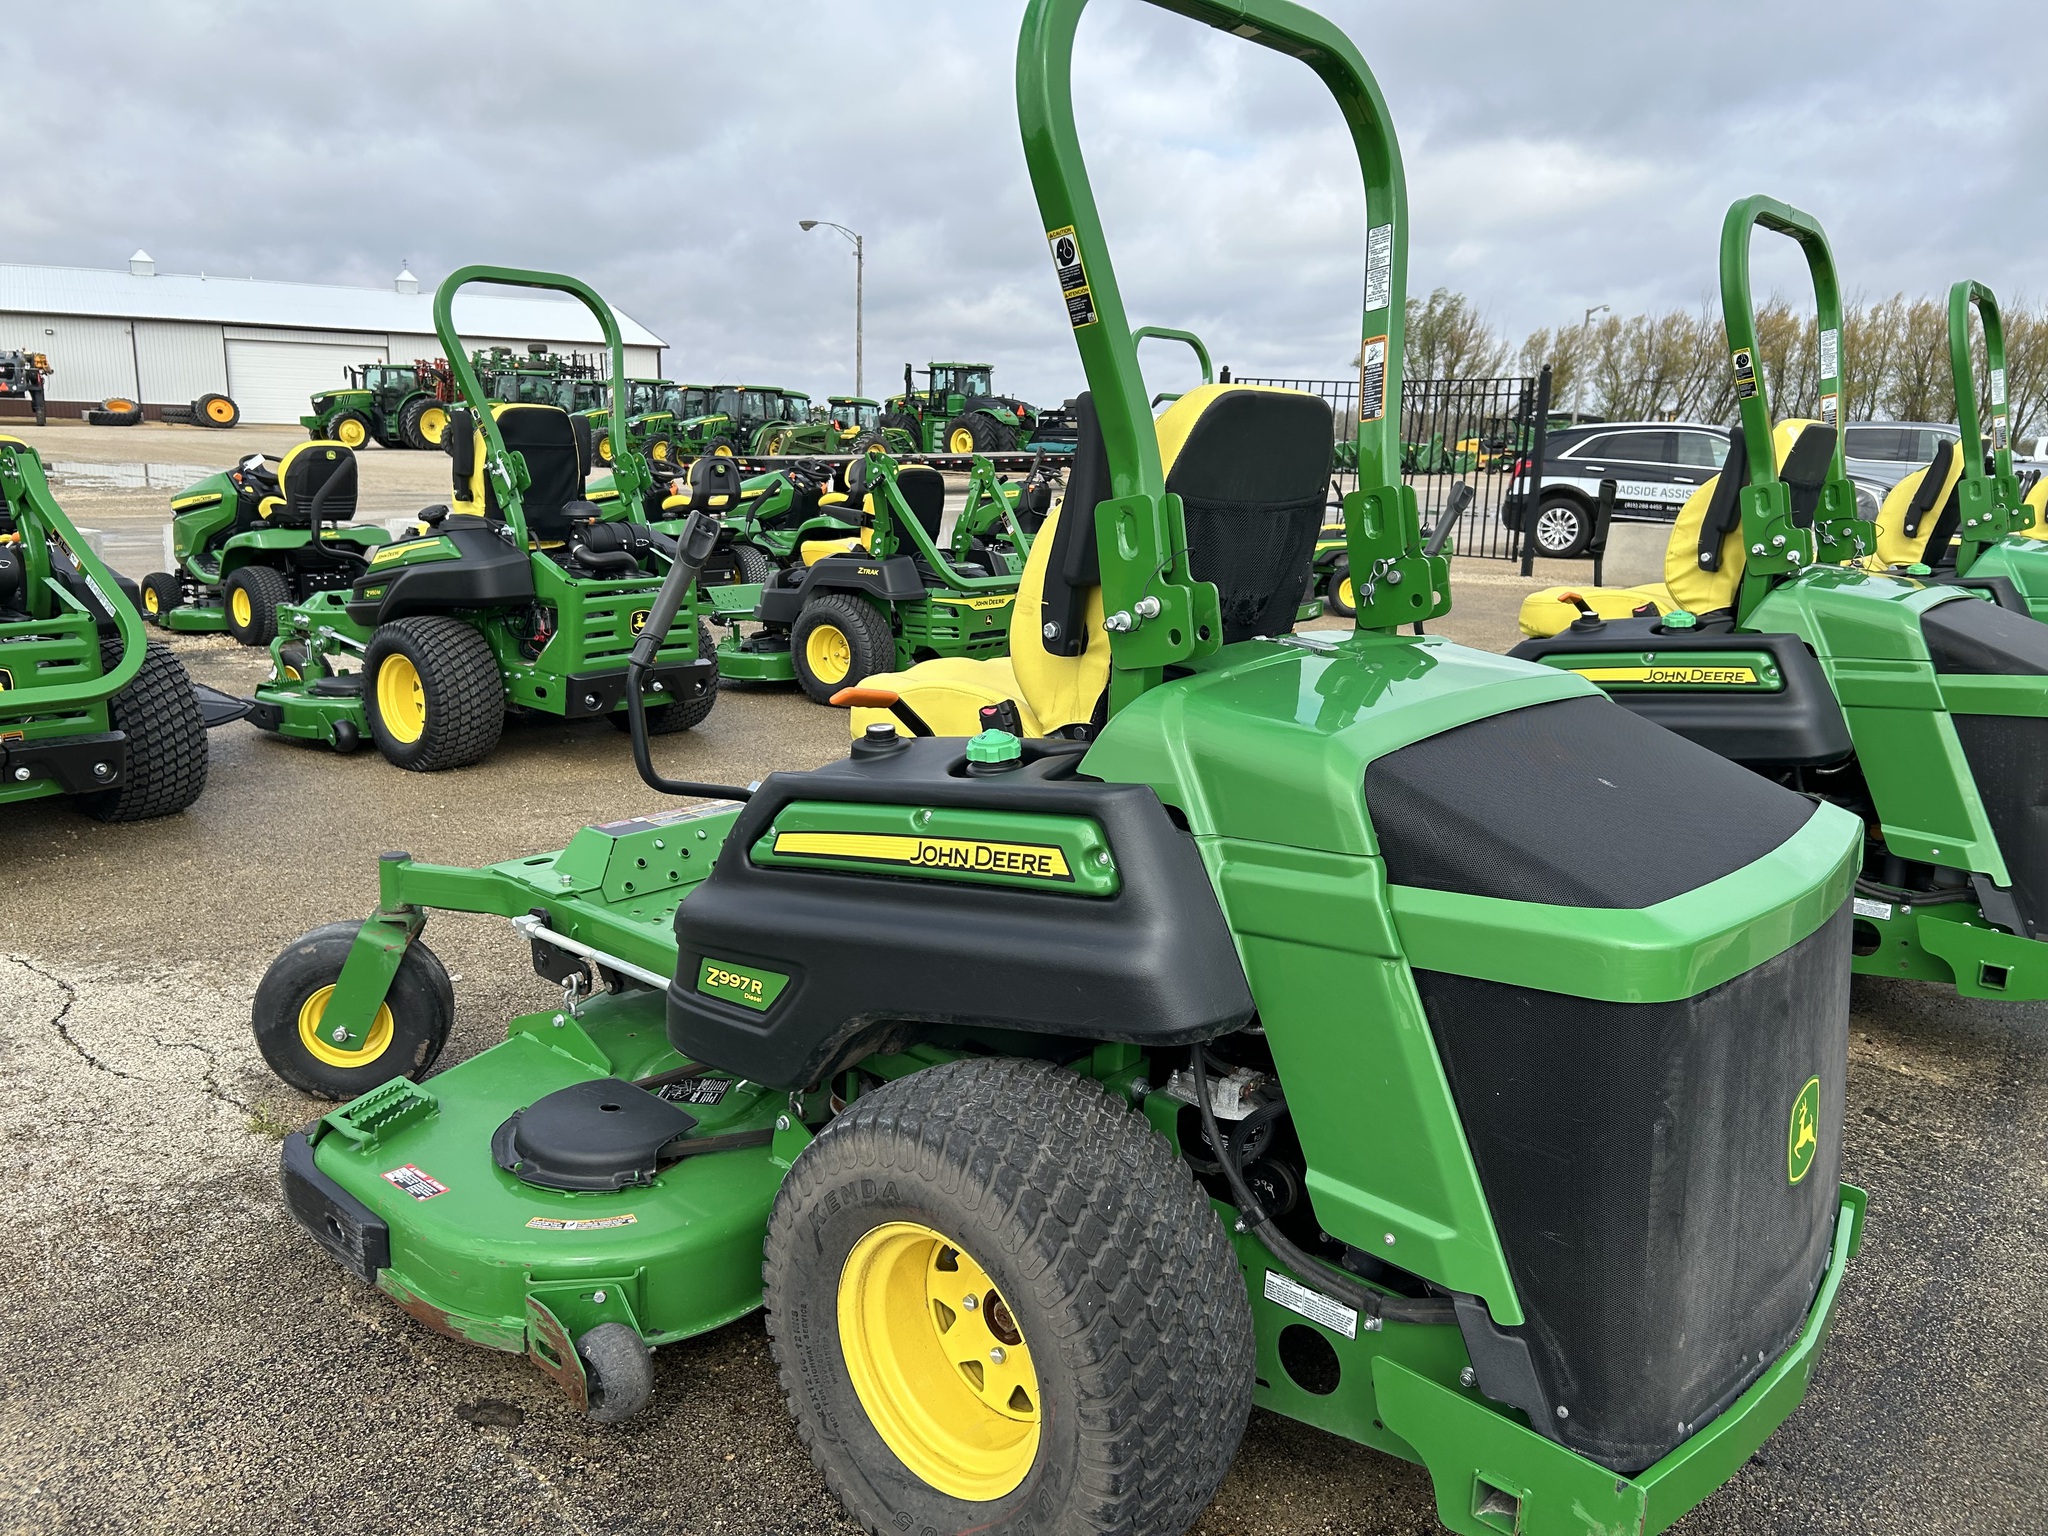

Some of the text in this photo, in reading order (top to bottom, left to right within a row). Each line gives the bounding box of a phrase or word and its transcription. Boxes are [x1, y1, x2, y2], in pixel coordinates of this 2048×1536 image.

[1052, 227, 1072, 238] CAUTION
[1616, 485, 1695, 499] ADSIDE ASSIS
[857, 567, 879, 576] ZTRAK
[974, 598, 1005, 607] JOHN DEERE
[1643, 669, 1746, 682] JOHN DEERE
[909, 841, 1052, 873] JOHN DEERE
[743, 992, 763, 1003] Diesel
[808, 1178, 901, 1245] KENDA
[804, 1345, 821, 1384] HIGHWAY
[817, 1388, 830, 1406] FOR
[826, 1411, 840, 1429] NOT
